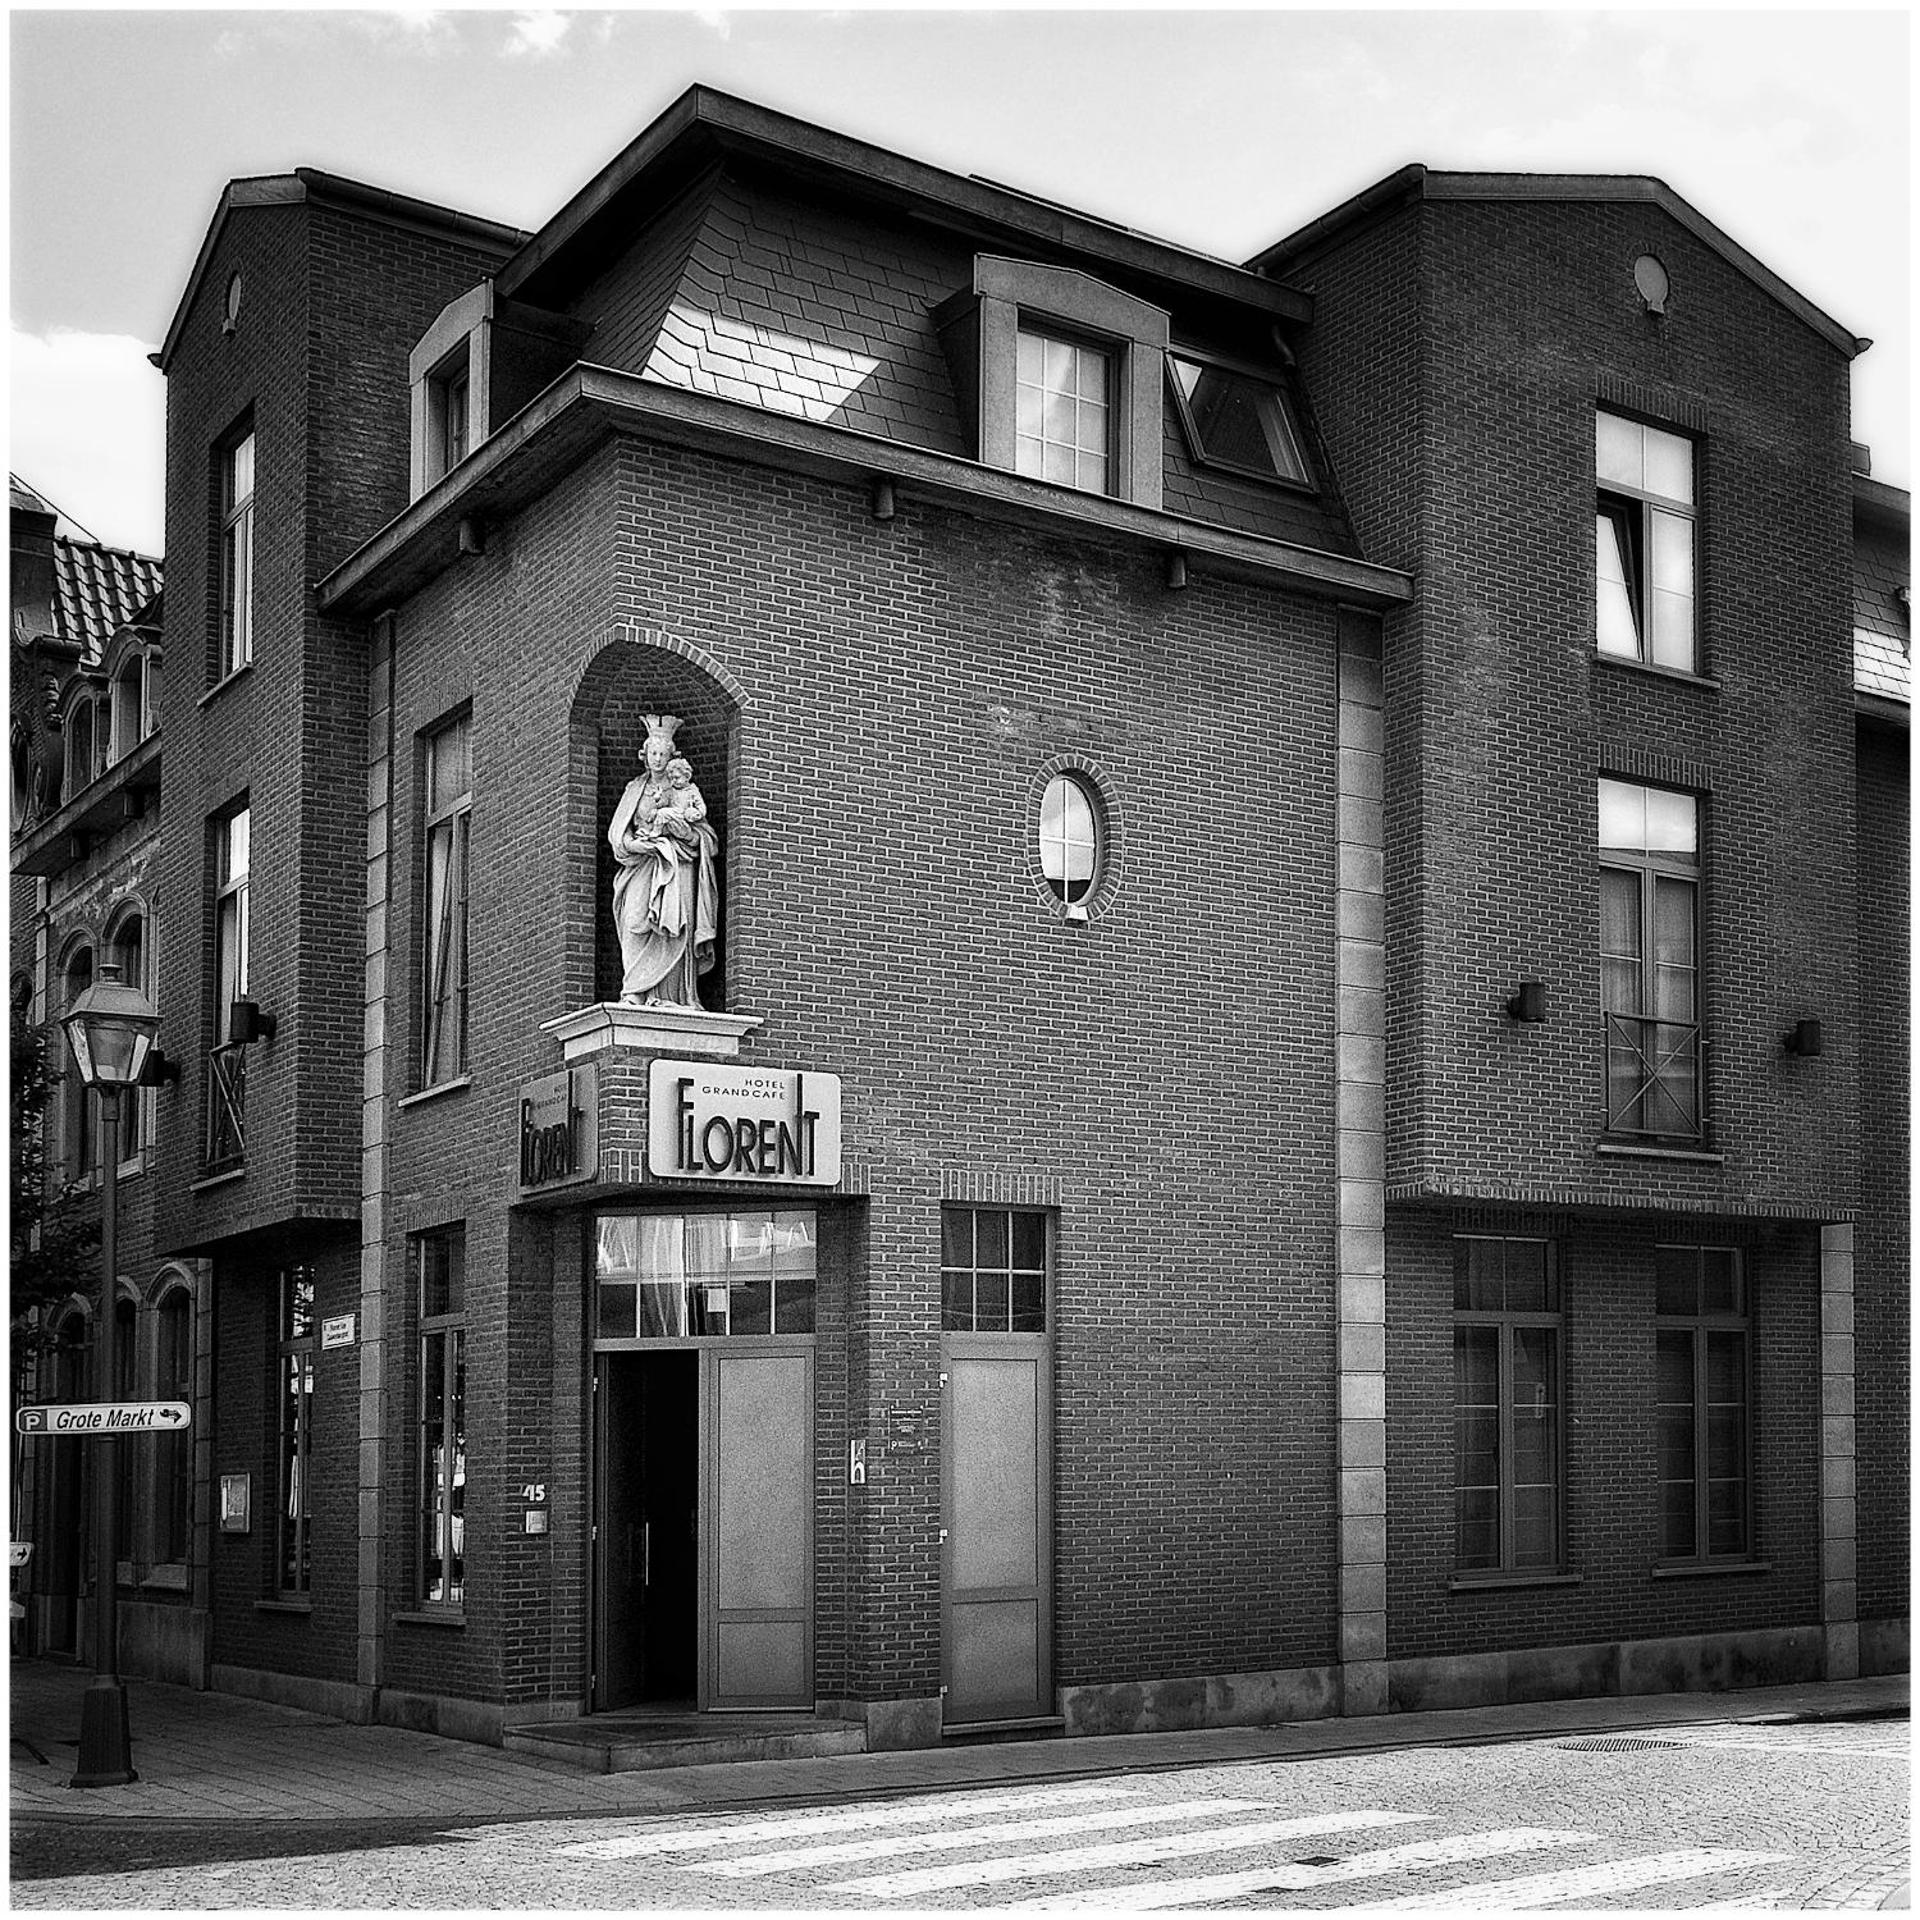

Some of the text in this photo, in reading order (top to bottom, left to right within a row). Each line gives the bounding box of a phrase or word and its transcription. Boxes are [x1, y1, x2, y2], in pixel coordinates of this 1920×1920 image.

[745, 1079, 785, 1089] HOTEL
[678, 1074, 820, 1176] FLORENT
[57, 1411, 102, 1429] Grote
[106, 1409, 155, 1427] Markt
